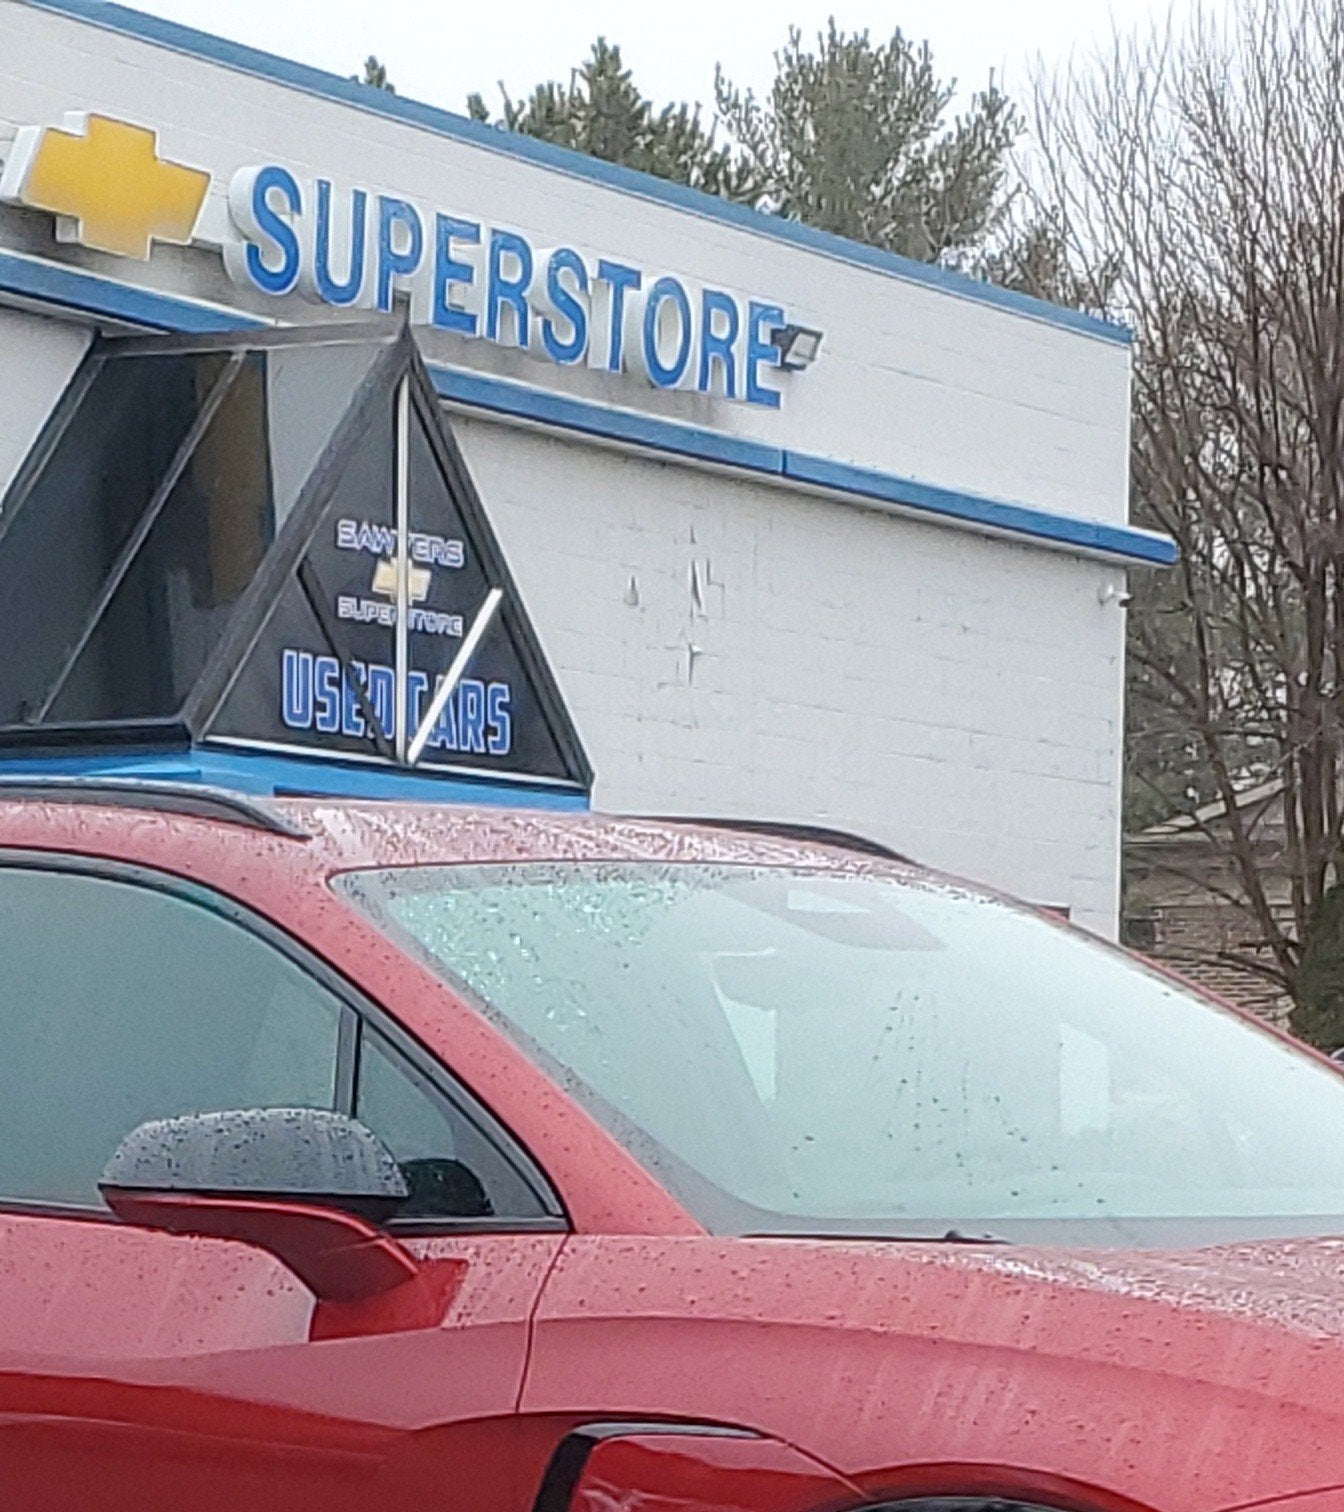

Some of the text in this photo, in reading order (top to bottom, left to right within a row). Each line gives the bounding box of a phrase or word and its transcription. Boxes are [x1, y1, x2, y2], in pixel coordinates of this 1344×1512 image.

[244, 164, 784, 410] SUPERSTORE
[282, 649, 512, 756] USED CARS
